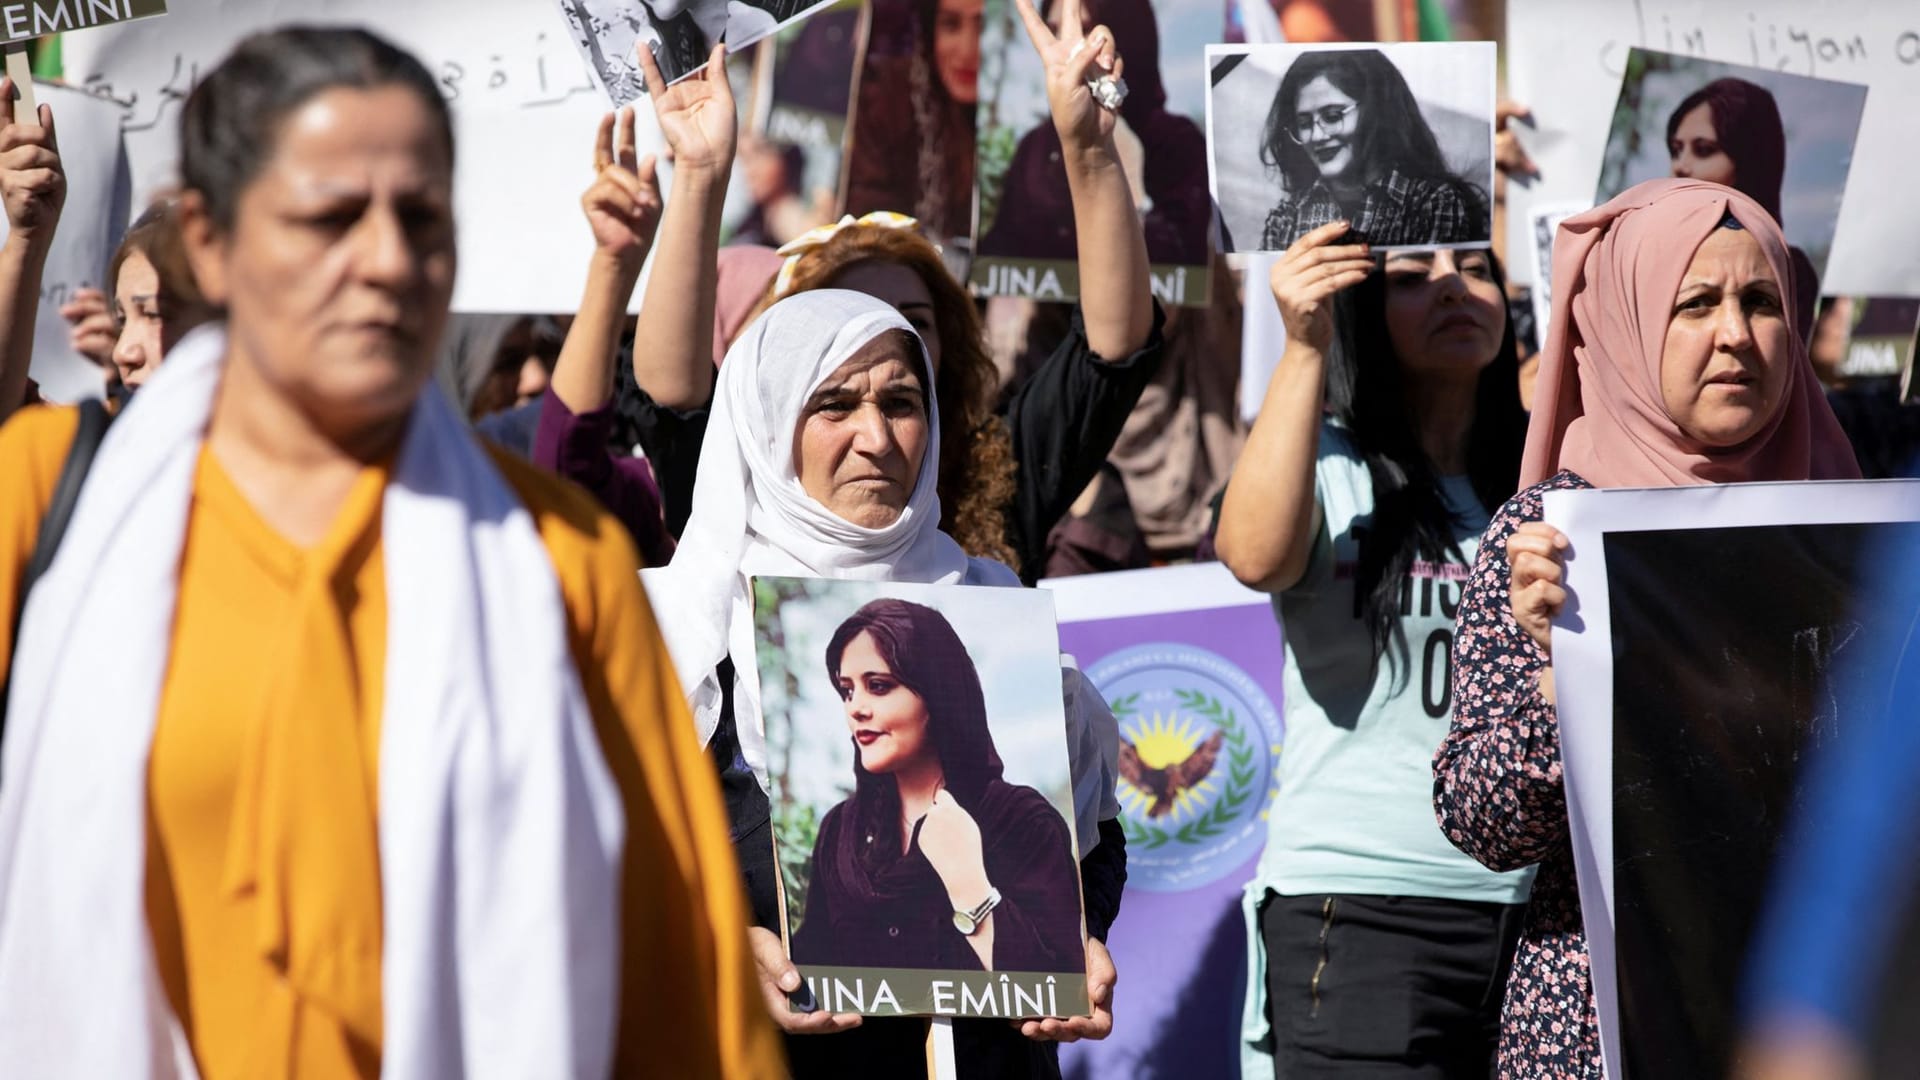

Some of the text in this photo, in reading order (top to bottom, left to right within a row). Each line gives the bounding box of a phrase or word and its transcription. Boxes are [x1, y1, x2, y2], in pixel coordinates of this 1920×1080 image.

[980, 264, 1064, 298] JINA
[798, 973, 1058, 1017] JINA EMÎNÎ
